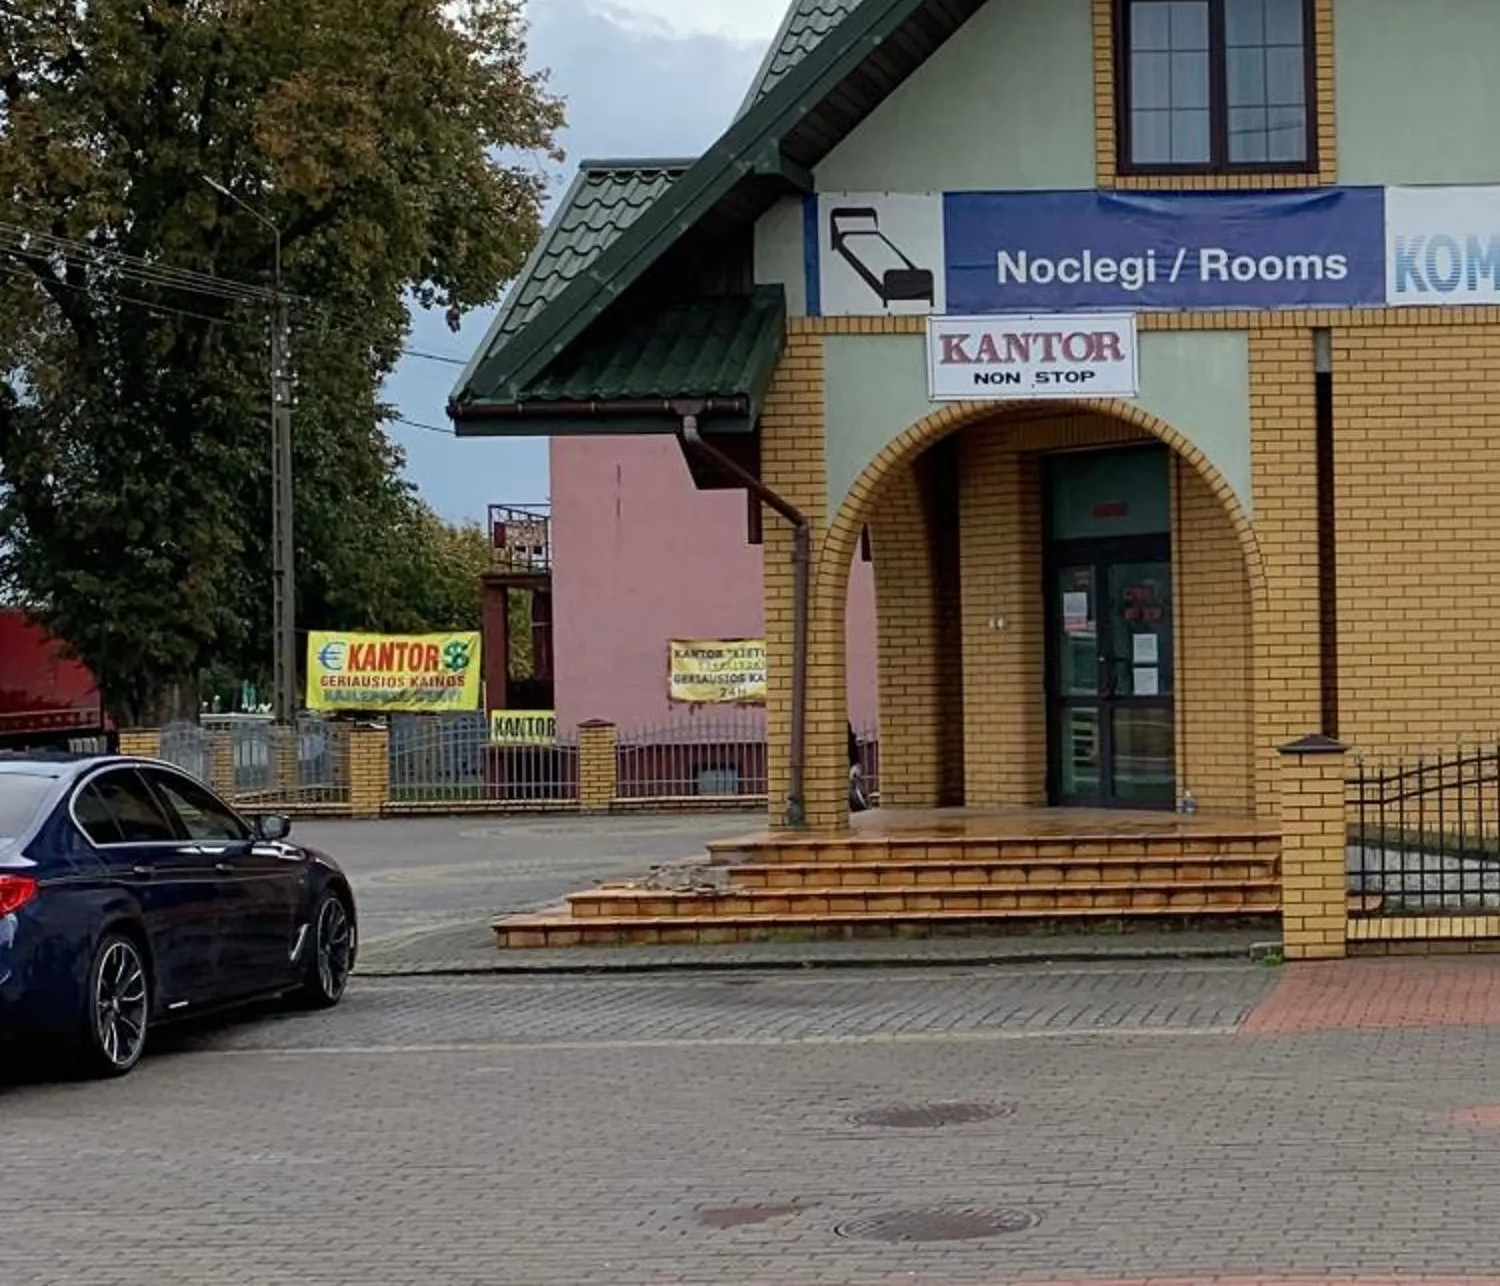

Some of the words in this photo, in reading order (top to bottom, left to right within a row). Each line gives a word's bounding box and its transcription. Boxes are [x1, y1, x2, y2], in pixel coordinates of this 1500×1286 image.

[997, 250, 1156, 292] Noclegi
[1200, 248, 1348, 283] Rooms
[938, 331, 1124, 366] KANTOR
[973, 370, 1022, 386] NON
[1035, 370, 1096, 385] STOP
[347, 641, 440, 672] KANTOR
[674, 649, 723, 659] KANTOR
[320, 675, 405, 687] GERIAUSIOS
[410, 675, 465, 687] KAINOS
[495, 717, 556, 737] KANTOR
